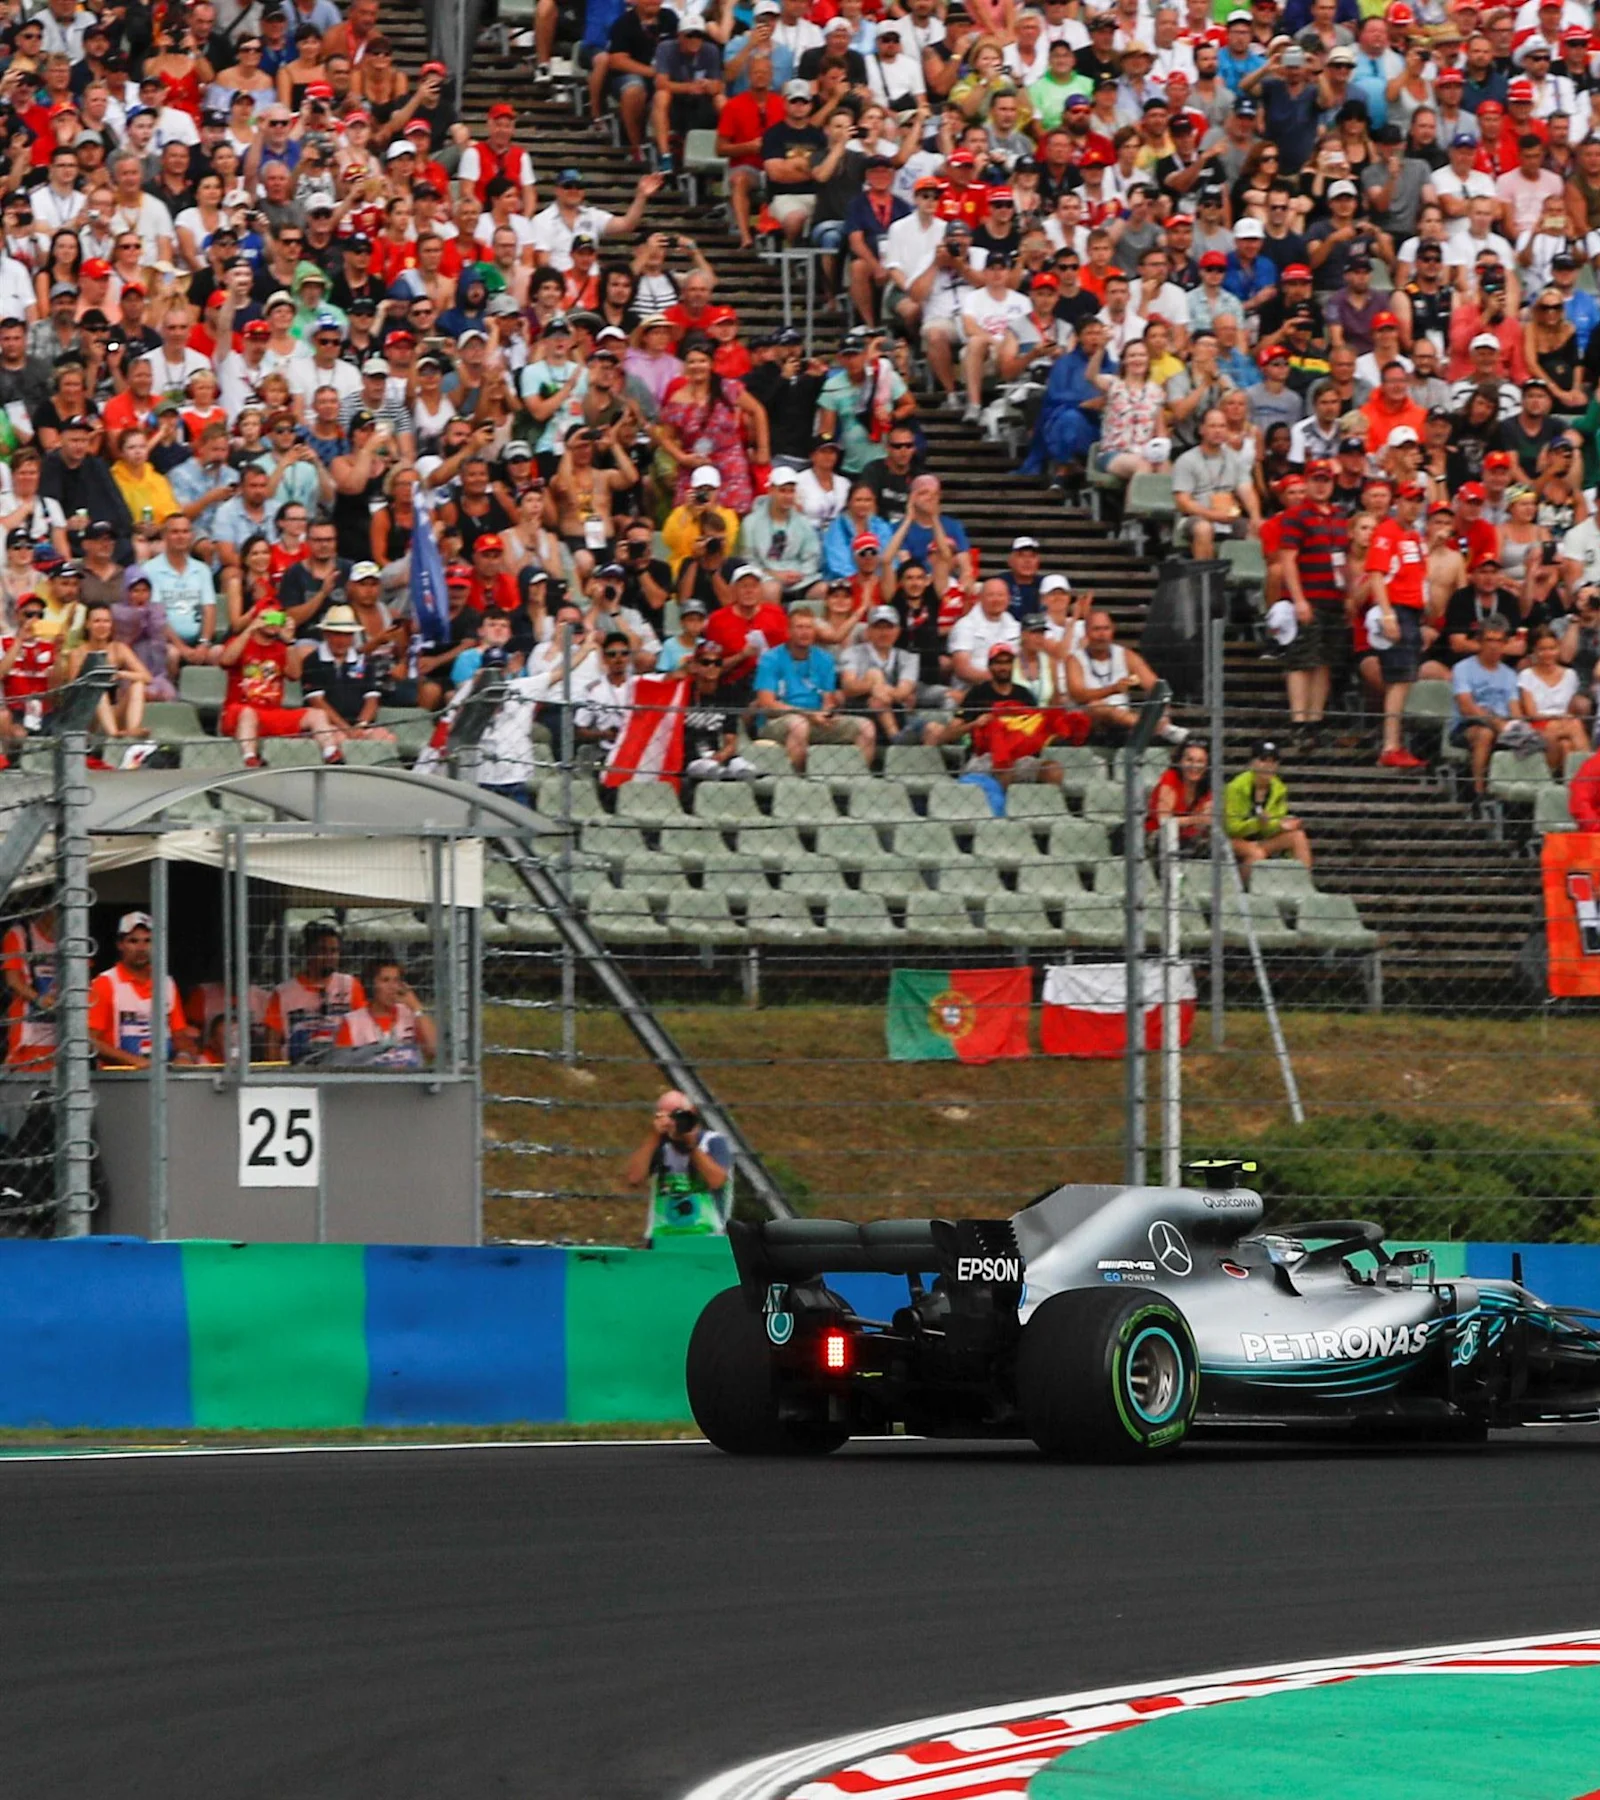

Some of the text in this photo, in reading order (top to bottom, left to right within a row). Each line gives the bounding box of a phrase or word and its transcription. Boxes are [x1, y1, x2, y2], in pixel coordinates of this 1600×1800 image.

[247, 1107, 314, 1167] 25
[1202, 1195, 1258, 1210] Qualcomm
[958, 1257, 1019, 1282] EPSON
[1240, 1322, 1430, 1362] PETRONAS
